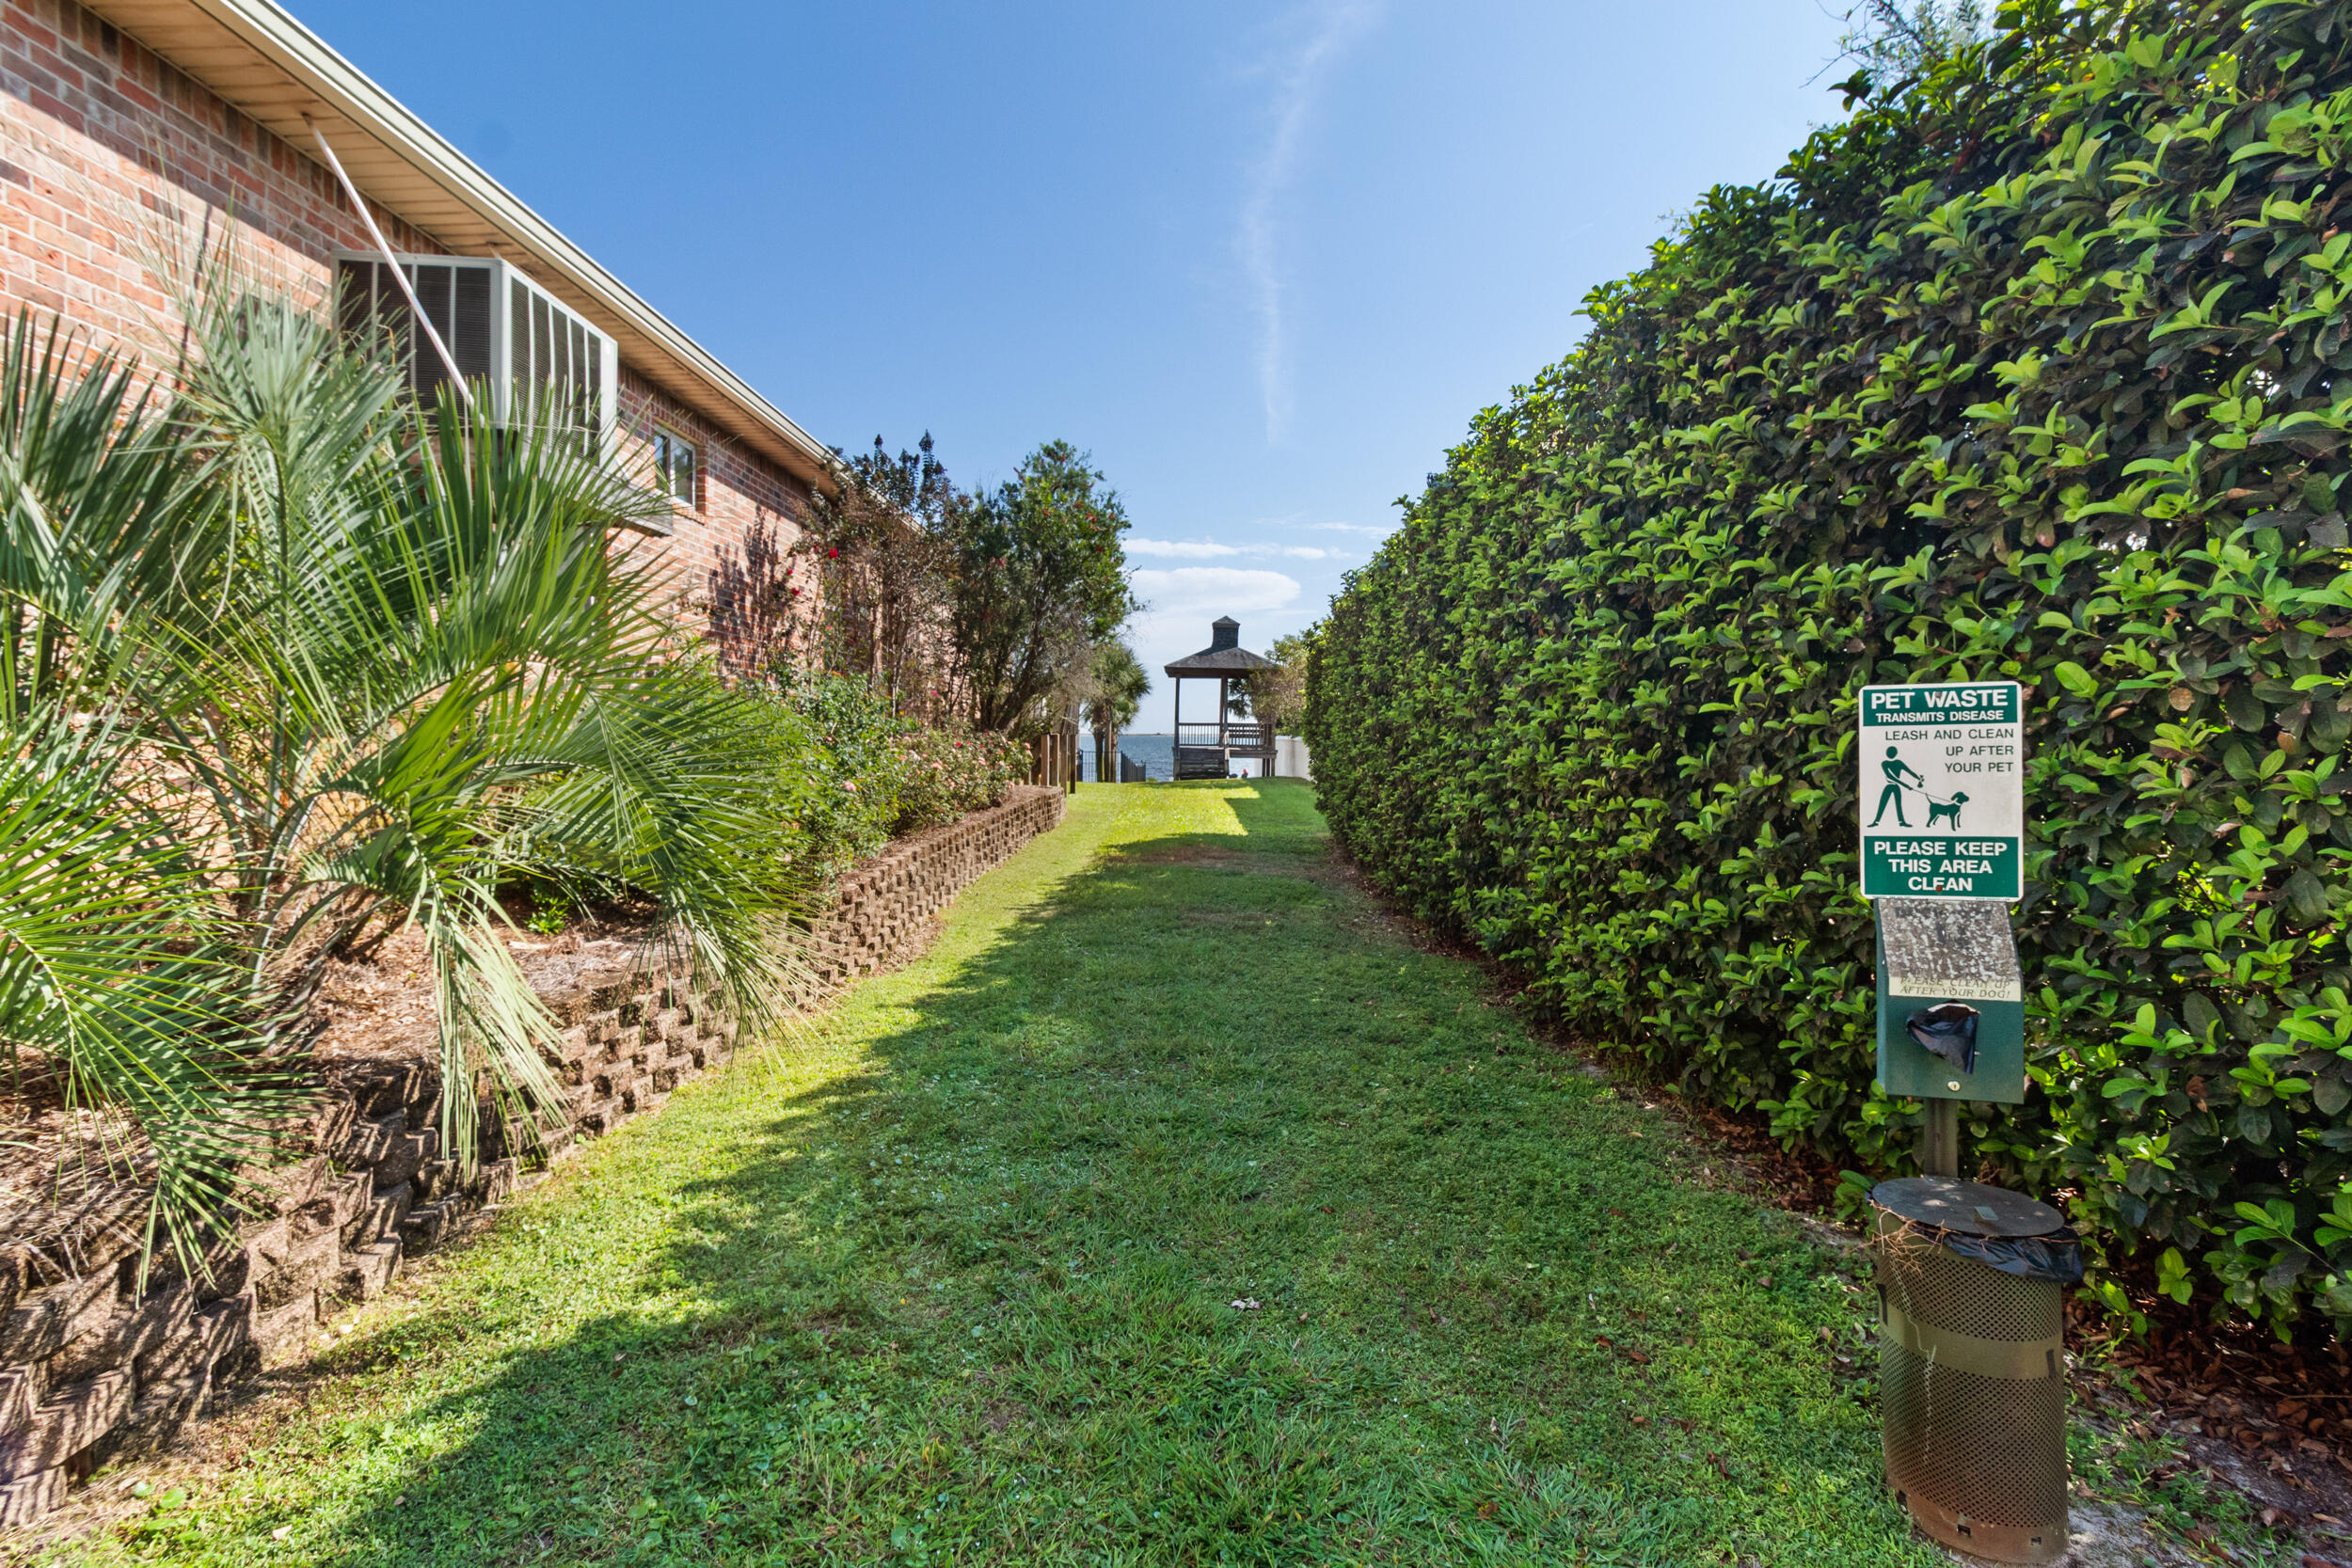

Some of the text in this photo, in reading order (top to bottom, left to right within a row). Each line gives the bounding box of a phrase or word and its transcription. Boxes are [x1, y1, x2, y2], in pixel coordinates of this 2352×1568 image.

[1871, 689, 2009, 709] PET WASTE
[1876, 709, 2004, 723] TRANSMITS DISEASE
[1885, 728, 2014, 741] LEASH AND CLEAN
[1946, 745, 2014, 756] UP AFTER
[1945, 762, 2014, 773] YOUR PET
[1874, 841, 2008, 856] PLEASE KEEP
[1888, 859, 1993, 875] THIS AREA
[1908, 877, 1973, 892] CLEAN
